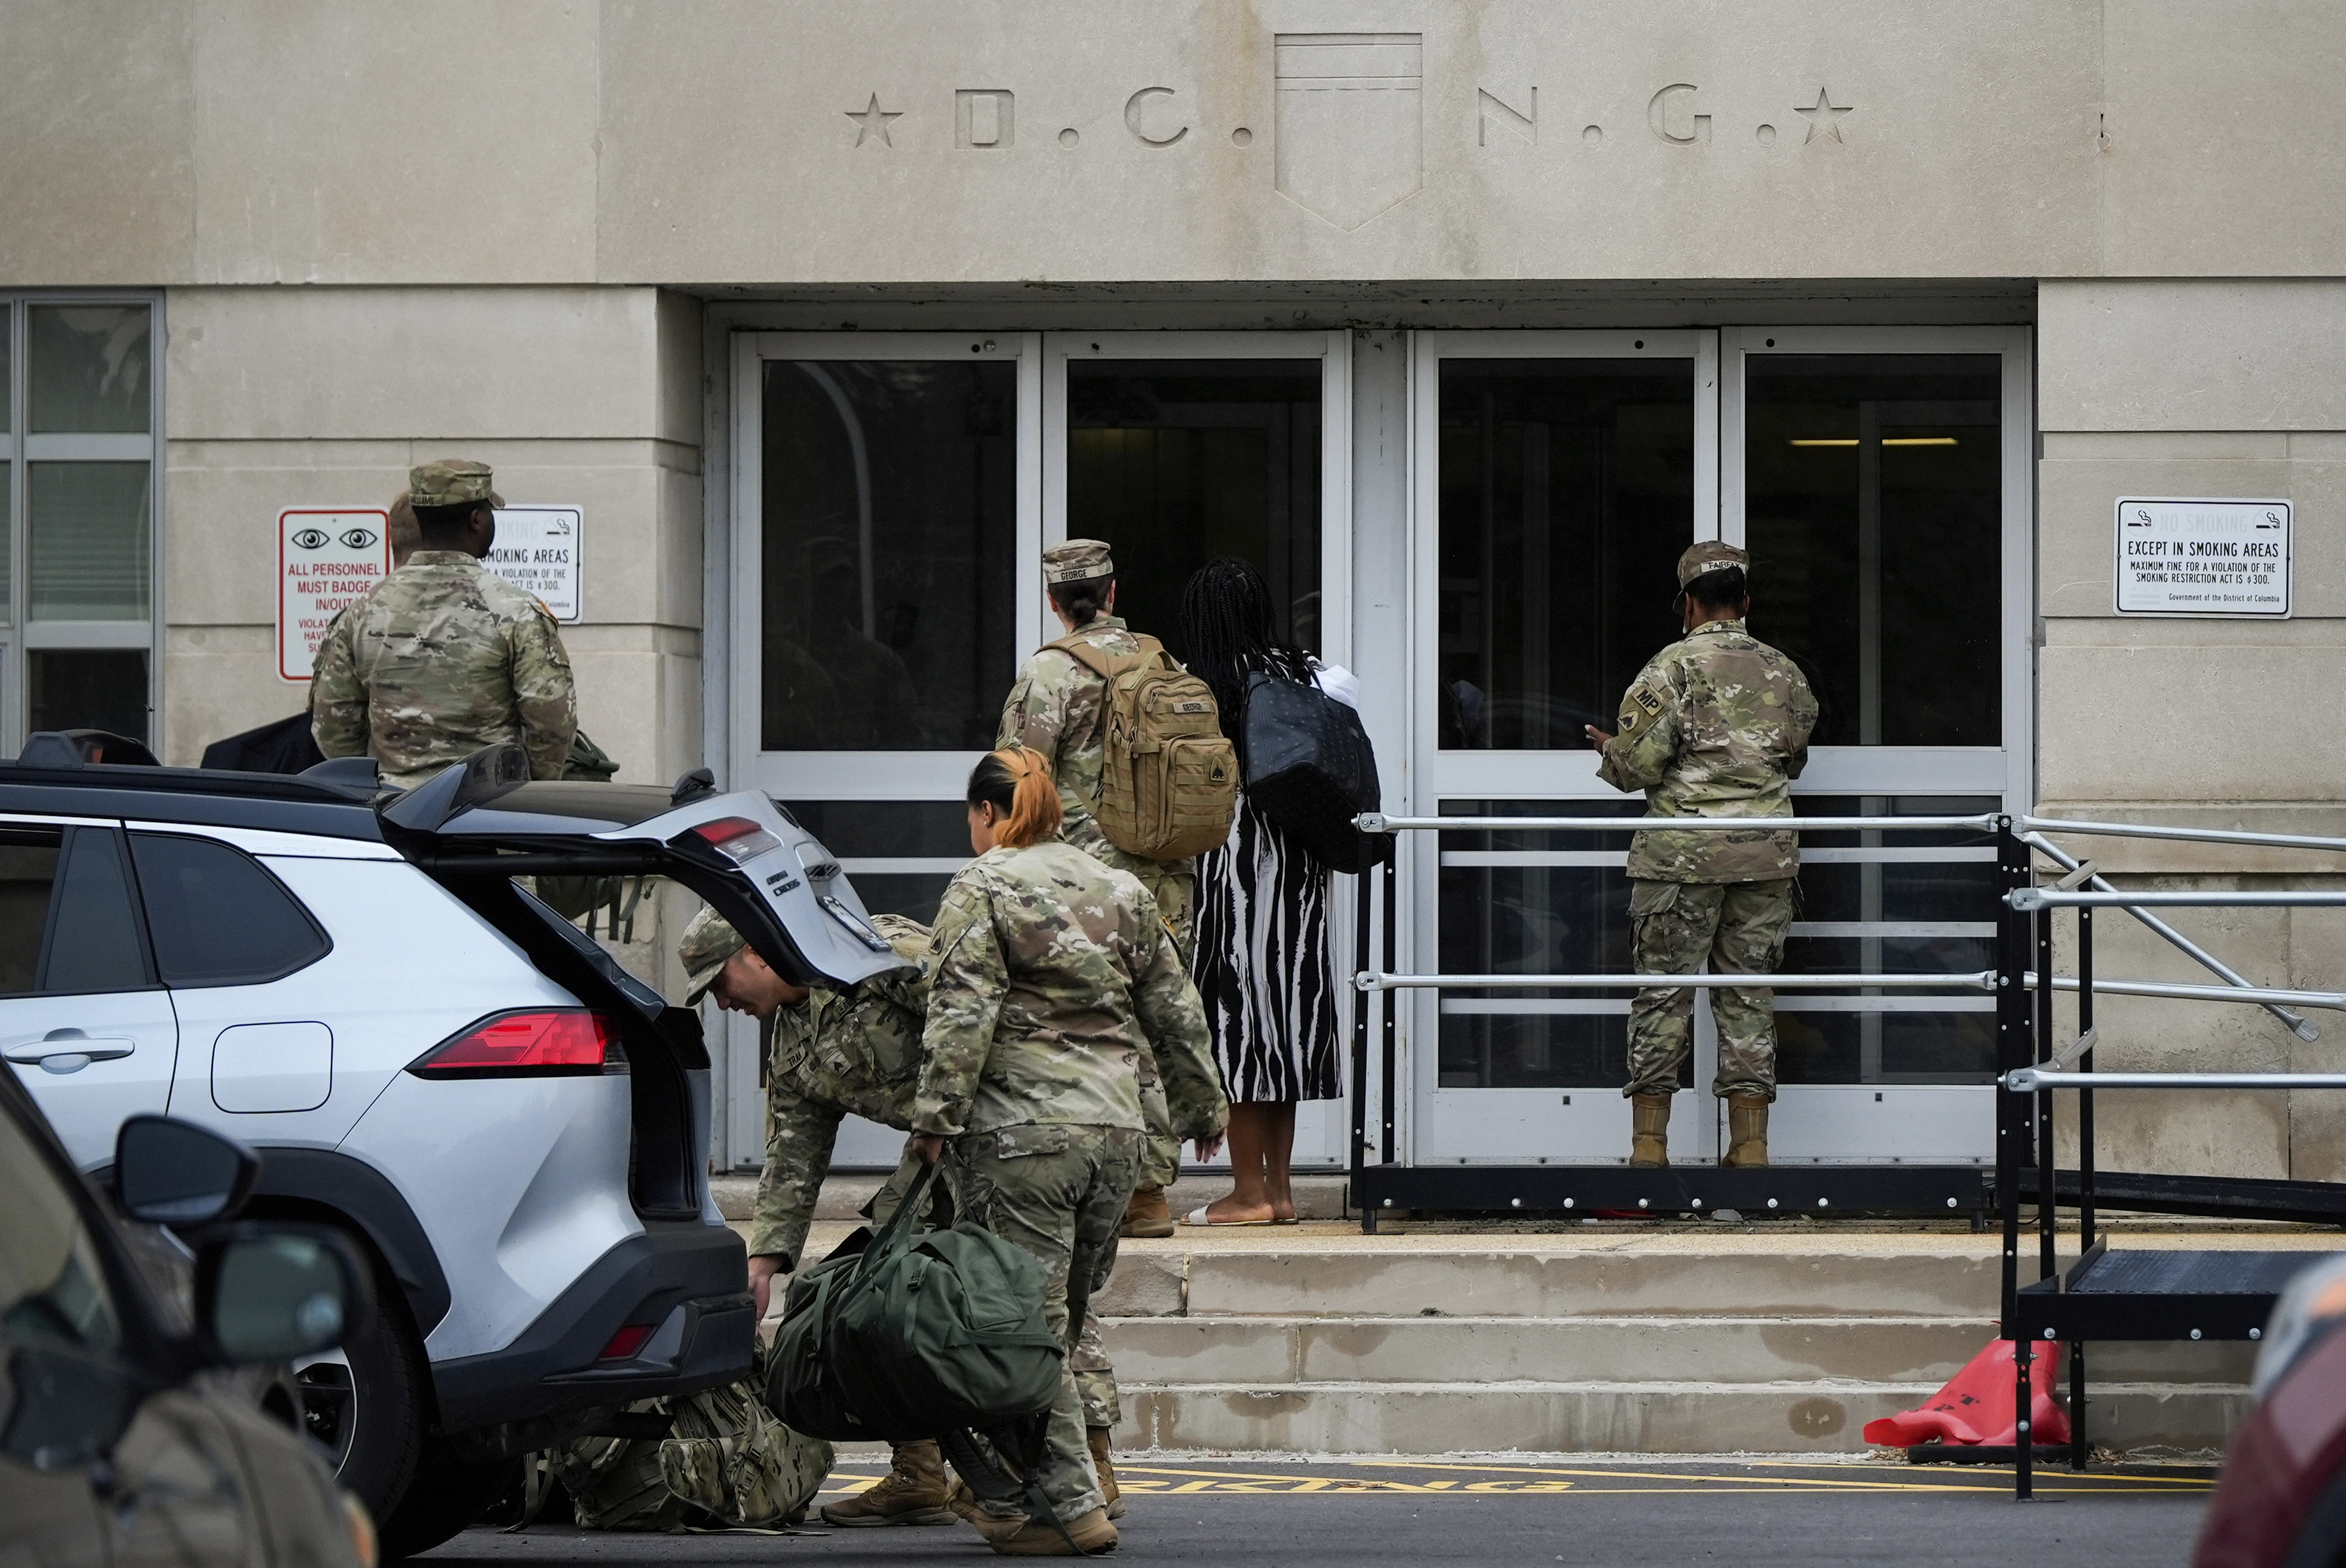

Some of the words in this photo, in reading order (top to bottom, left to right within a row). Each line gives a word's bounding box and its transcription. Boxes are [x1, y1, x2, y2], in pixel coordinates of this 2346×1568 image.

[2159, 513, 2179, 532] NO
[2186, 513, 2248, 533] SMOKING
[2128, 541, 2167, 555] EXCEPT
[2173, 541, 2183, 555] IN
[2189, 541, 2237, 557] SMOKING
[2243, 543, 2278, 557] AREAS
[534, 549, 569, 563] AREAS
[288, 564, 309, 576] ALL
[313, 563, 381, 576] PERSONNEL
[1708, 561, 1740, 569] FAIRFAX
[2131, 561, 2163, 571] MAXIMUM
[2167, 561, 2182, 571] FINE
[2186, 562, 2199, 571] FOR
[2203, 562, 2208, 571] A
[2211, 562, 2247, 572] VIOLATION
[2251, 563, 2260, 572] OF
[2263, 563, 2276, 572] THE
[502, 568, 538, 578] VIOLATION
[542, 569, 550, 578] OF
[554, 569, 566, 579] THE
[1060, 569, 1087, 580] GEORGE
[2136, 572, 2168, 582] SMOKING
[2172, 574, 2217, 583] RESTRICTION
[2220, 574, 2233, 583] ACT
[2236, 574, 2243, 583] IS
[298, 581, 329, 593] MUST
[332, 581, 371, 593] BADGE
[526, 580, 534, 590] IS
[2169, 593, 2202, 602] Government
[316, 597, 352, 610] IN/OUT
[299, 618, 331, 629] VIOLAT
[1637, 689, 1659, 709] MP
[1182, 702, 1203, 711] GEORGE
